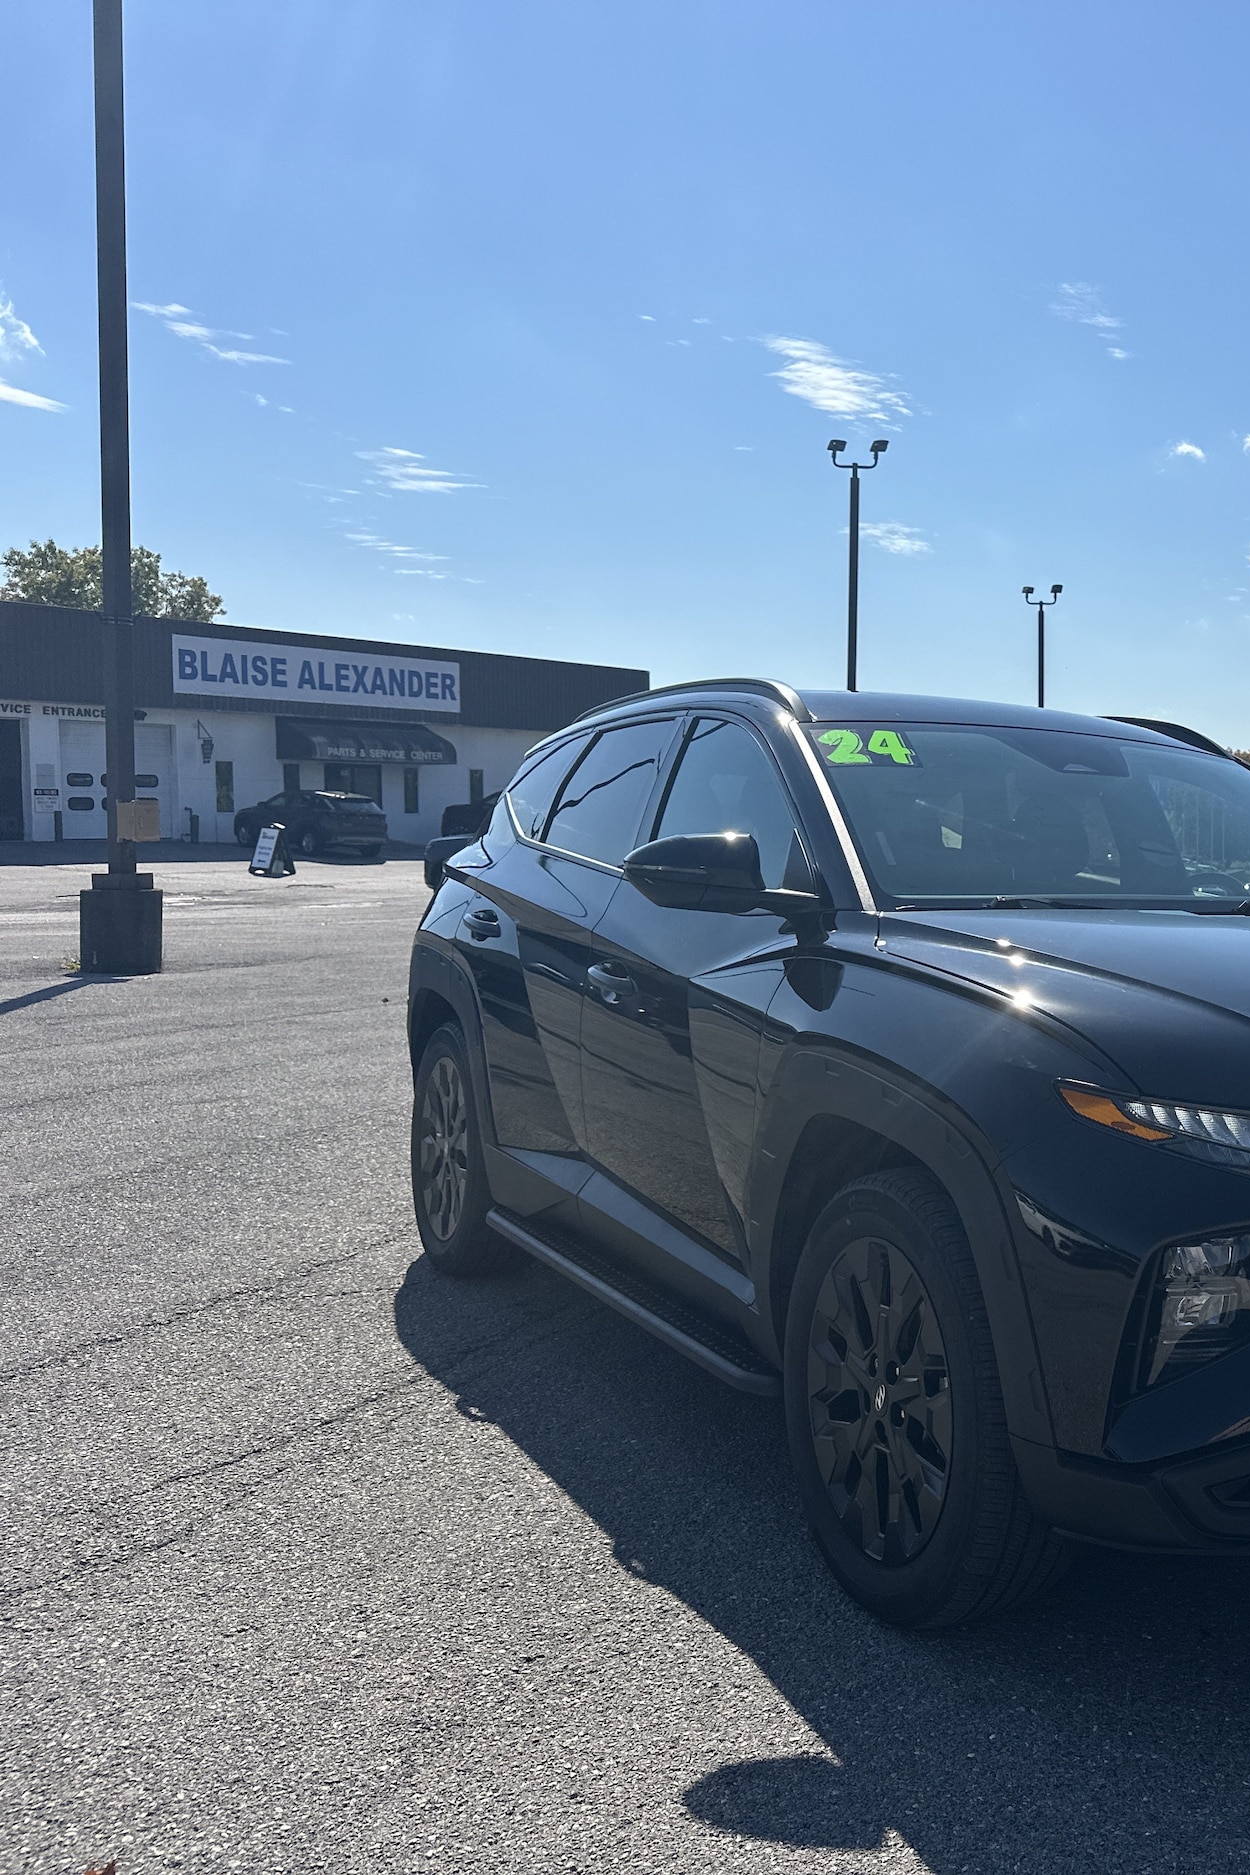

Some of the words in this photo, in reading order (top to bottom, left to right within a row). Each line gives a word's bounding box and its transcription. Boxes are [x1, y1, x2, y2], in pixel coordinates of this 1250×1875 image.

[178, 648, 287, 688] BLAISE
[298, 660, 457, 700] ALEXANDER
[327, 746, 357, 758] PARTS
[359, 748, 366, 757] &
[369, 748, 405, 759] SERVICE
[410, 751, 443, 760] CENTER
[817, 729, 915, 765] 24
